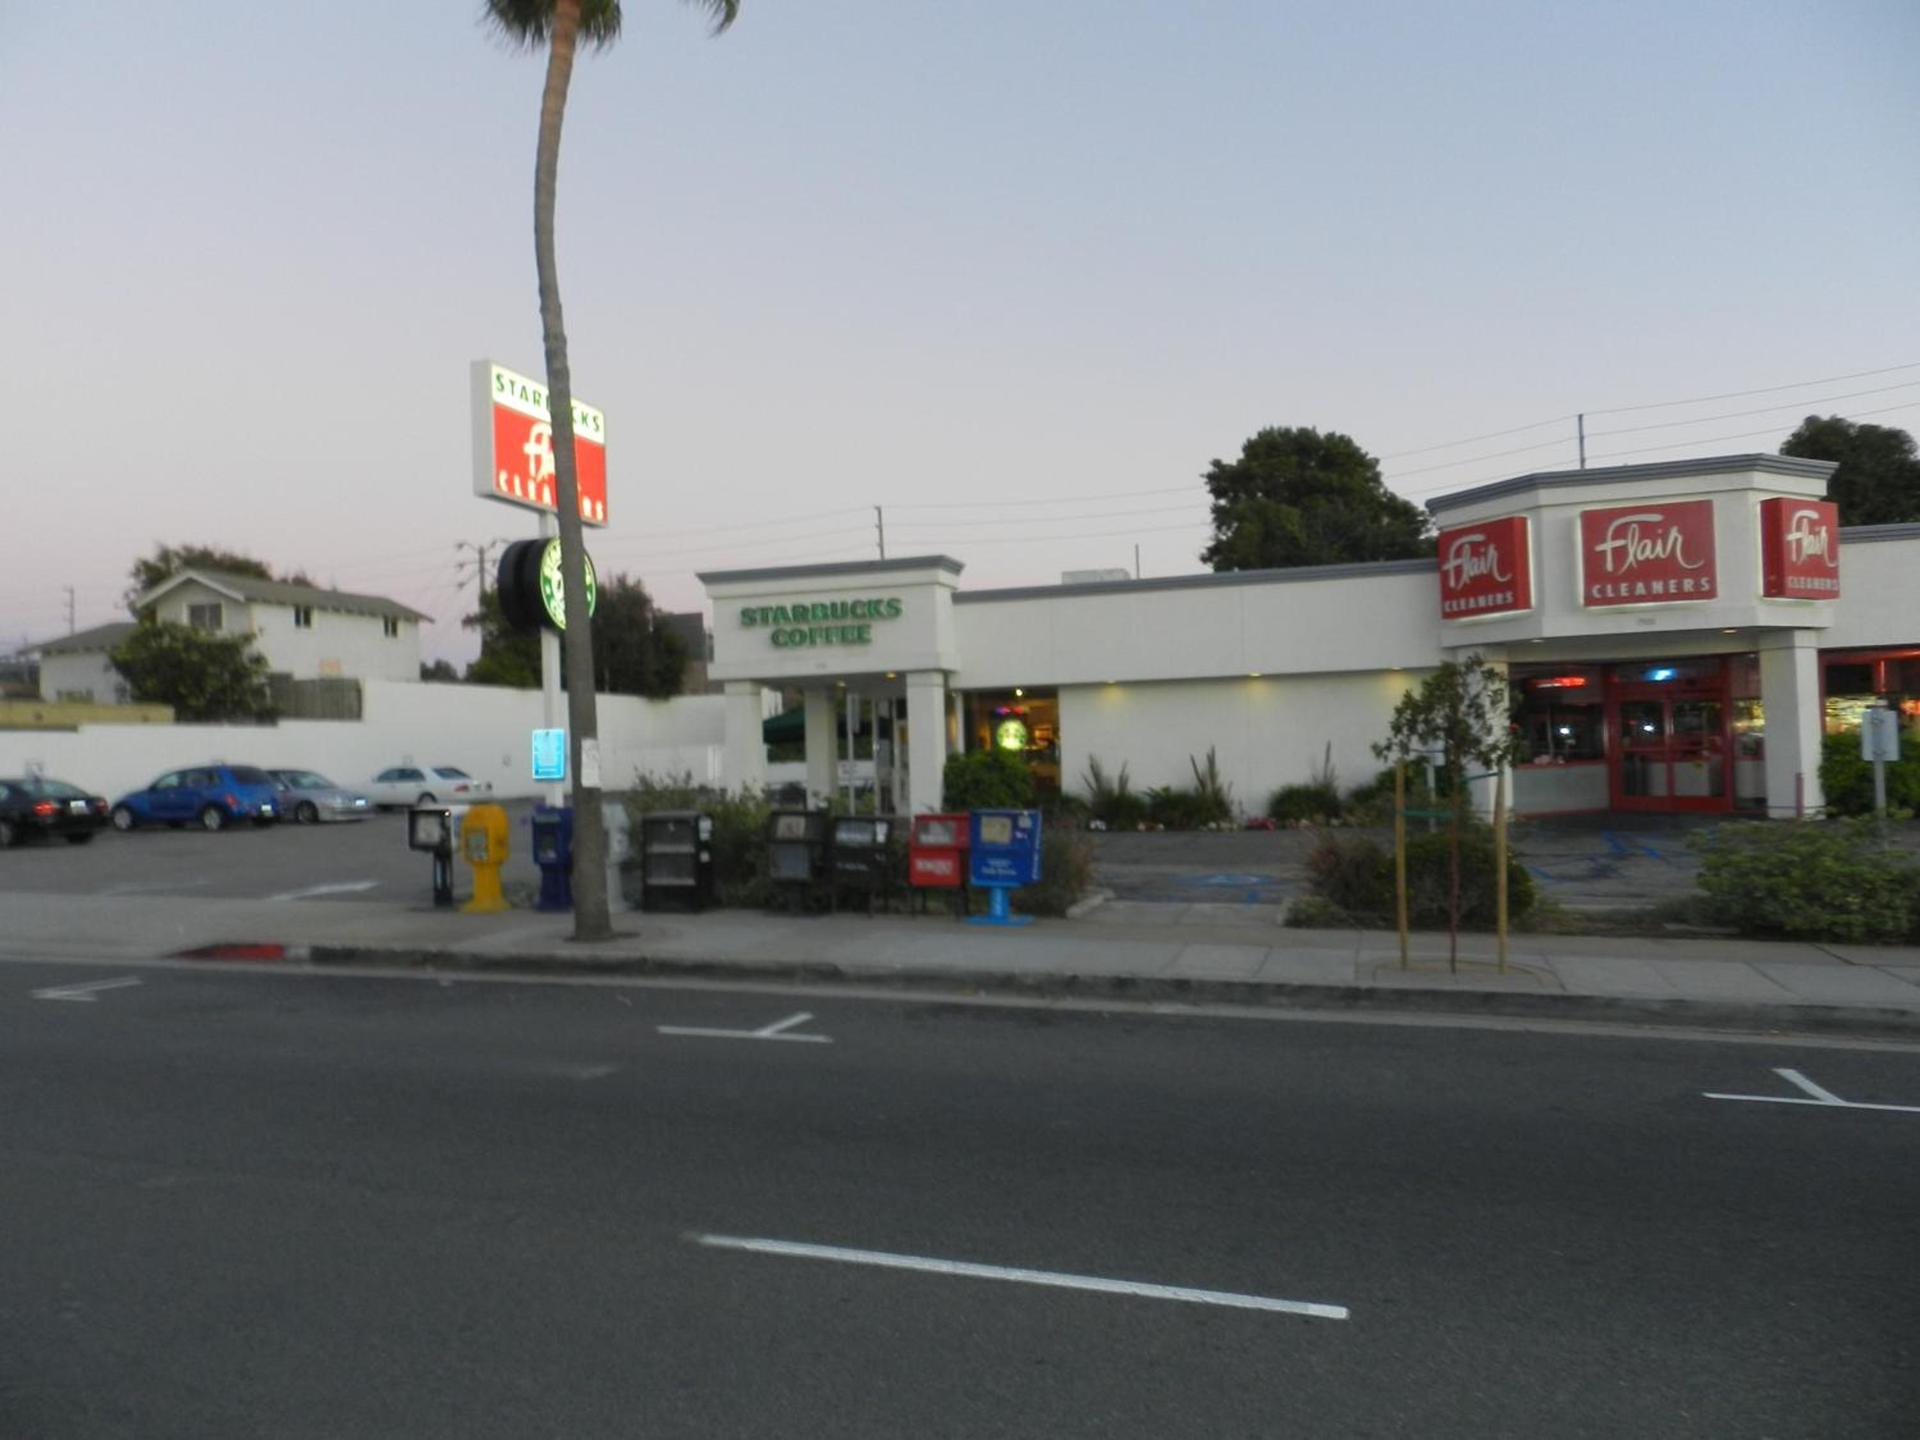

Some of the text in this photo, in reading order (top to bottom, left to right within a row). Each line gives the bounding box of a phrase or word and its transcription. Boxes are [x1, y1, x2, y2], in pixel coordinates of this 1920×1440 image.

[1594, 513, 1705, 576] Flair
[1786, 510, 1837, 566] Flair
[1441, 534, 1512, 590] Flair
[1592, 576, 1710, 598] CLEANERS
[740, 598, 903, 626] STARBUCKS
[771, 624, 872, 647] COFFEE
